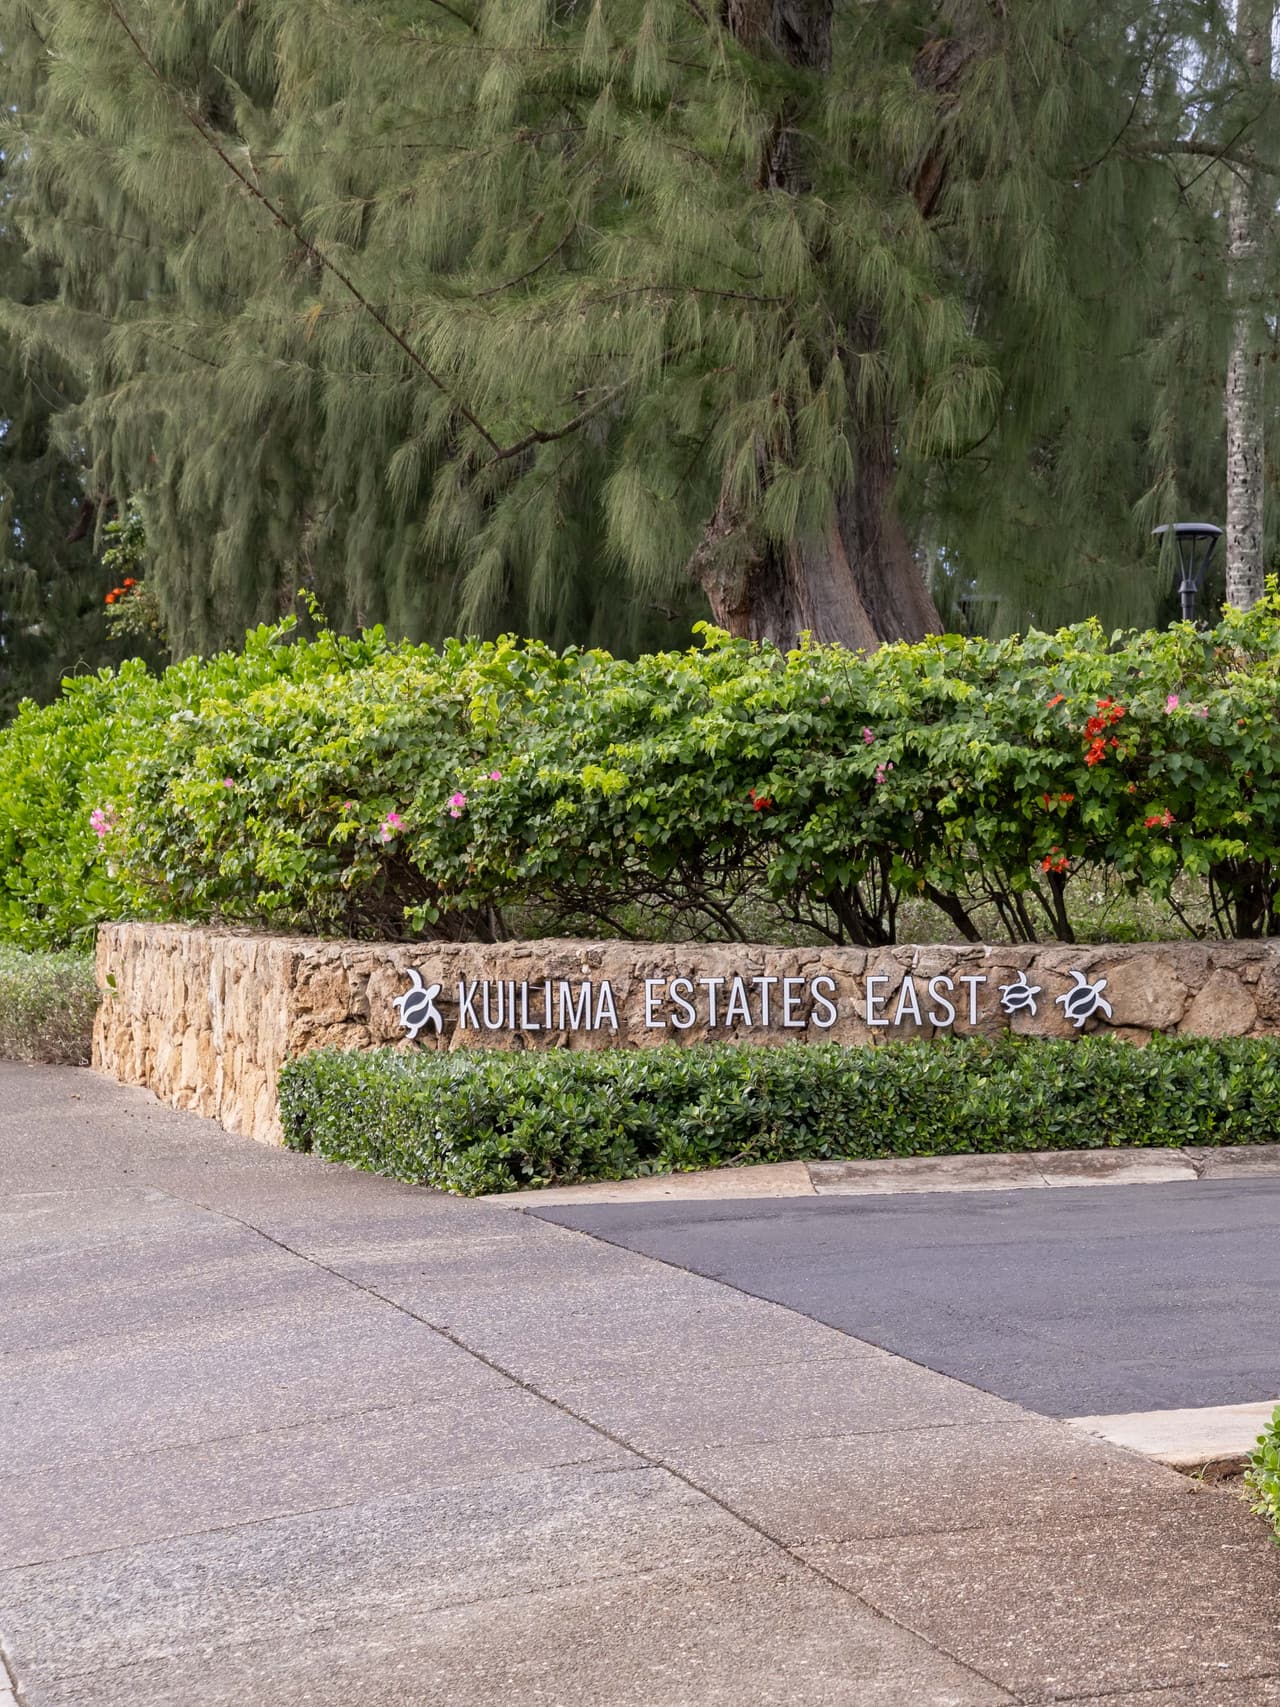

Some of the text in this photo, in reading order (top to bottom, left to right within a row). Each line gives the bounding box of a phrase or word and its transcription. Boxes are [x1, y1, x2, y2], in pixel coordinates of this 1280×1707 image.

[458, 975, 988, 1031] KUILIMA ESTATES EAST
